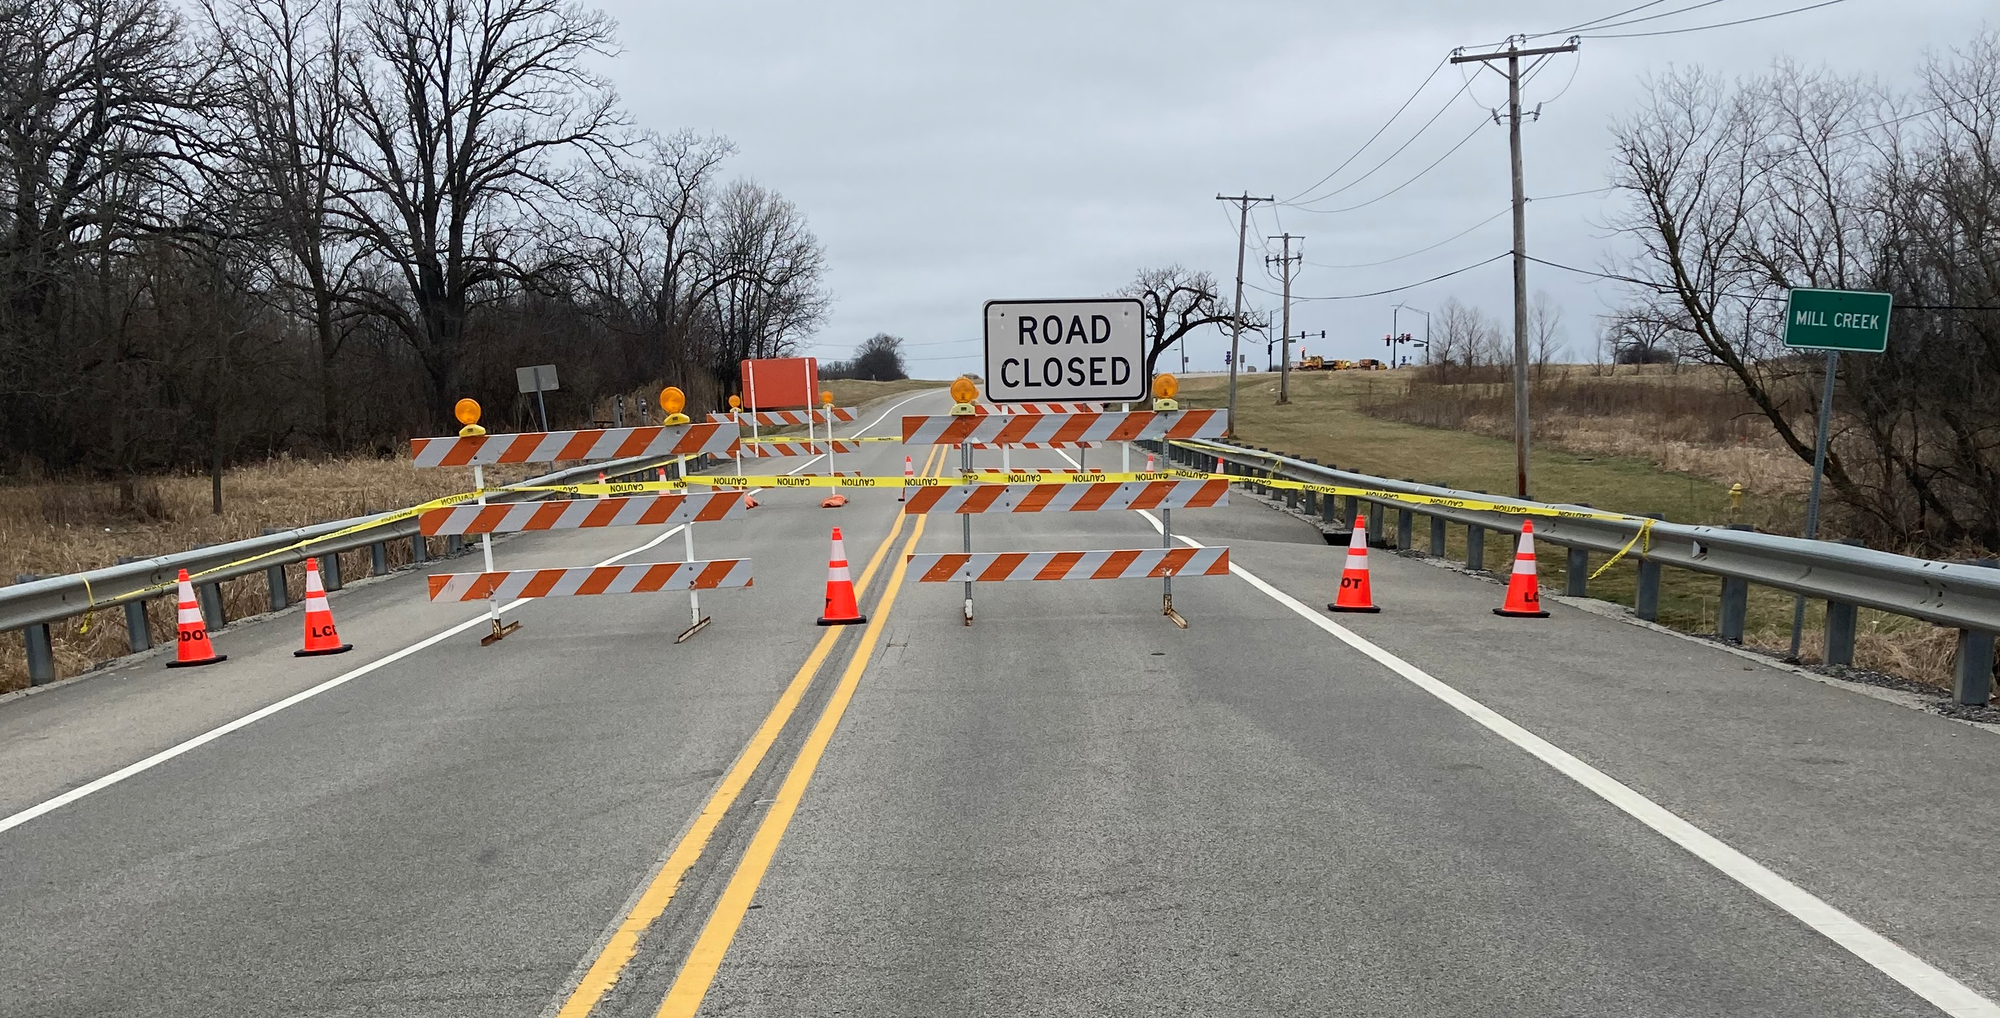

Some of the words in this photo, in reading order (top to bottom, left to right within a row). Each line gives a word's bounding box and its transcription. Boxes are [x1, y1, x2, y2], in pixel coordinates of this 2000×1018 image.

[1796, 311, 1828, 327] MILL
[1833, 312, 1880, 330] CREEK
[1018, 315, 1111, 345] ROAD
[1000, 357, 1131, 388] CLOSED
[1008, 474, 1042, 482] CAUTION
[1073, 474, 1106, 482] CAUTION
[1135, 472, 1169, 481] CAUTION
[1175, 470, 1209, 479] CAUTION
[713, 477, 748, 485] CAUTION
[776, 477, 811, 486] CAUTION
[841, 478, 875, 486] CAUTION
[905, 478, 938, 486] CAUTION
[610, 483, 644, 493] CAUTION
[1493, 504, 1527, 513] CAUTION
